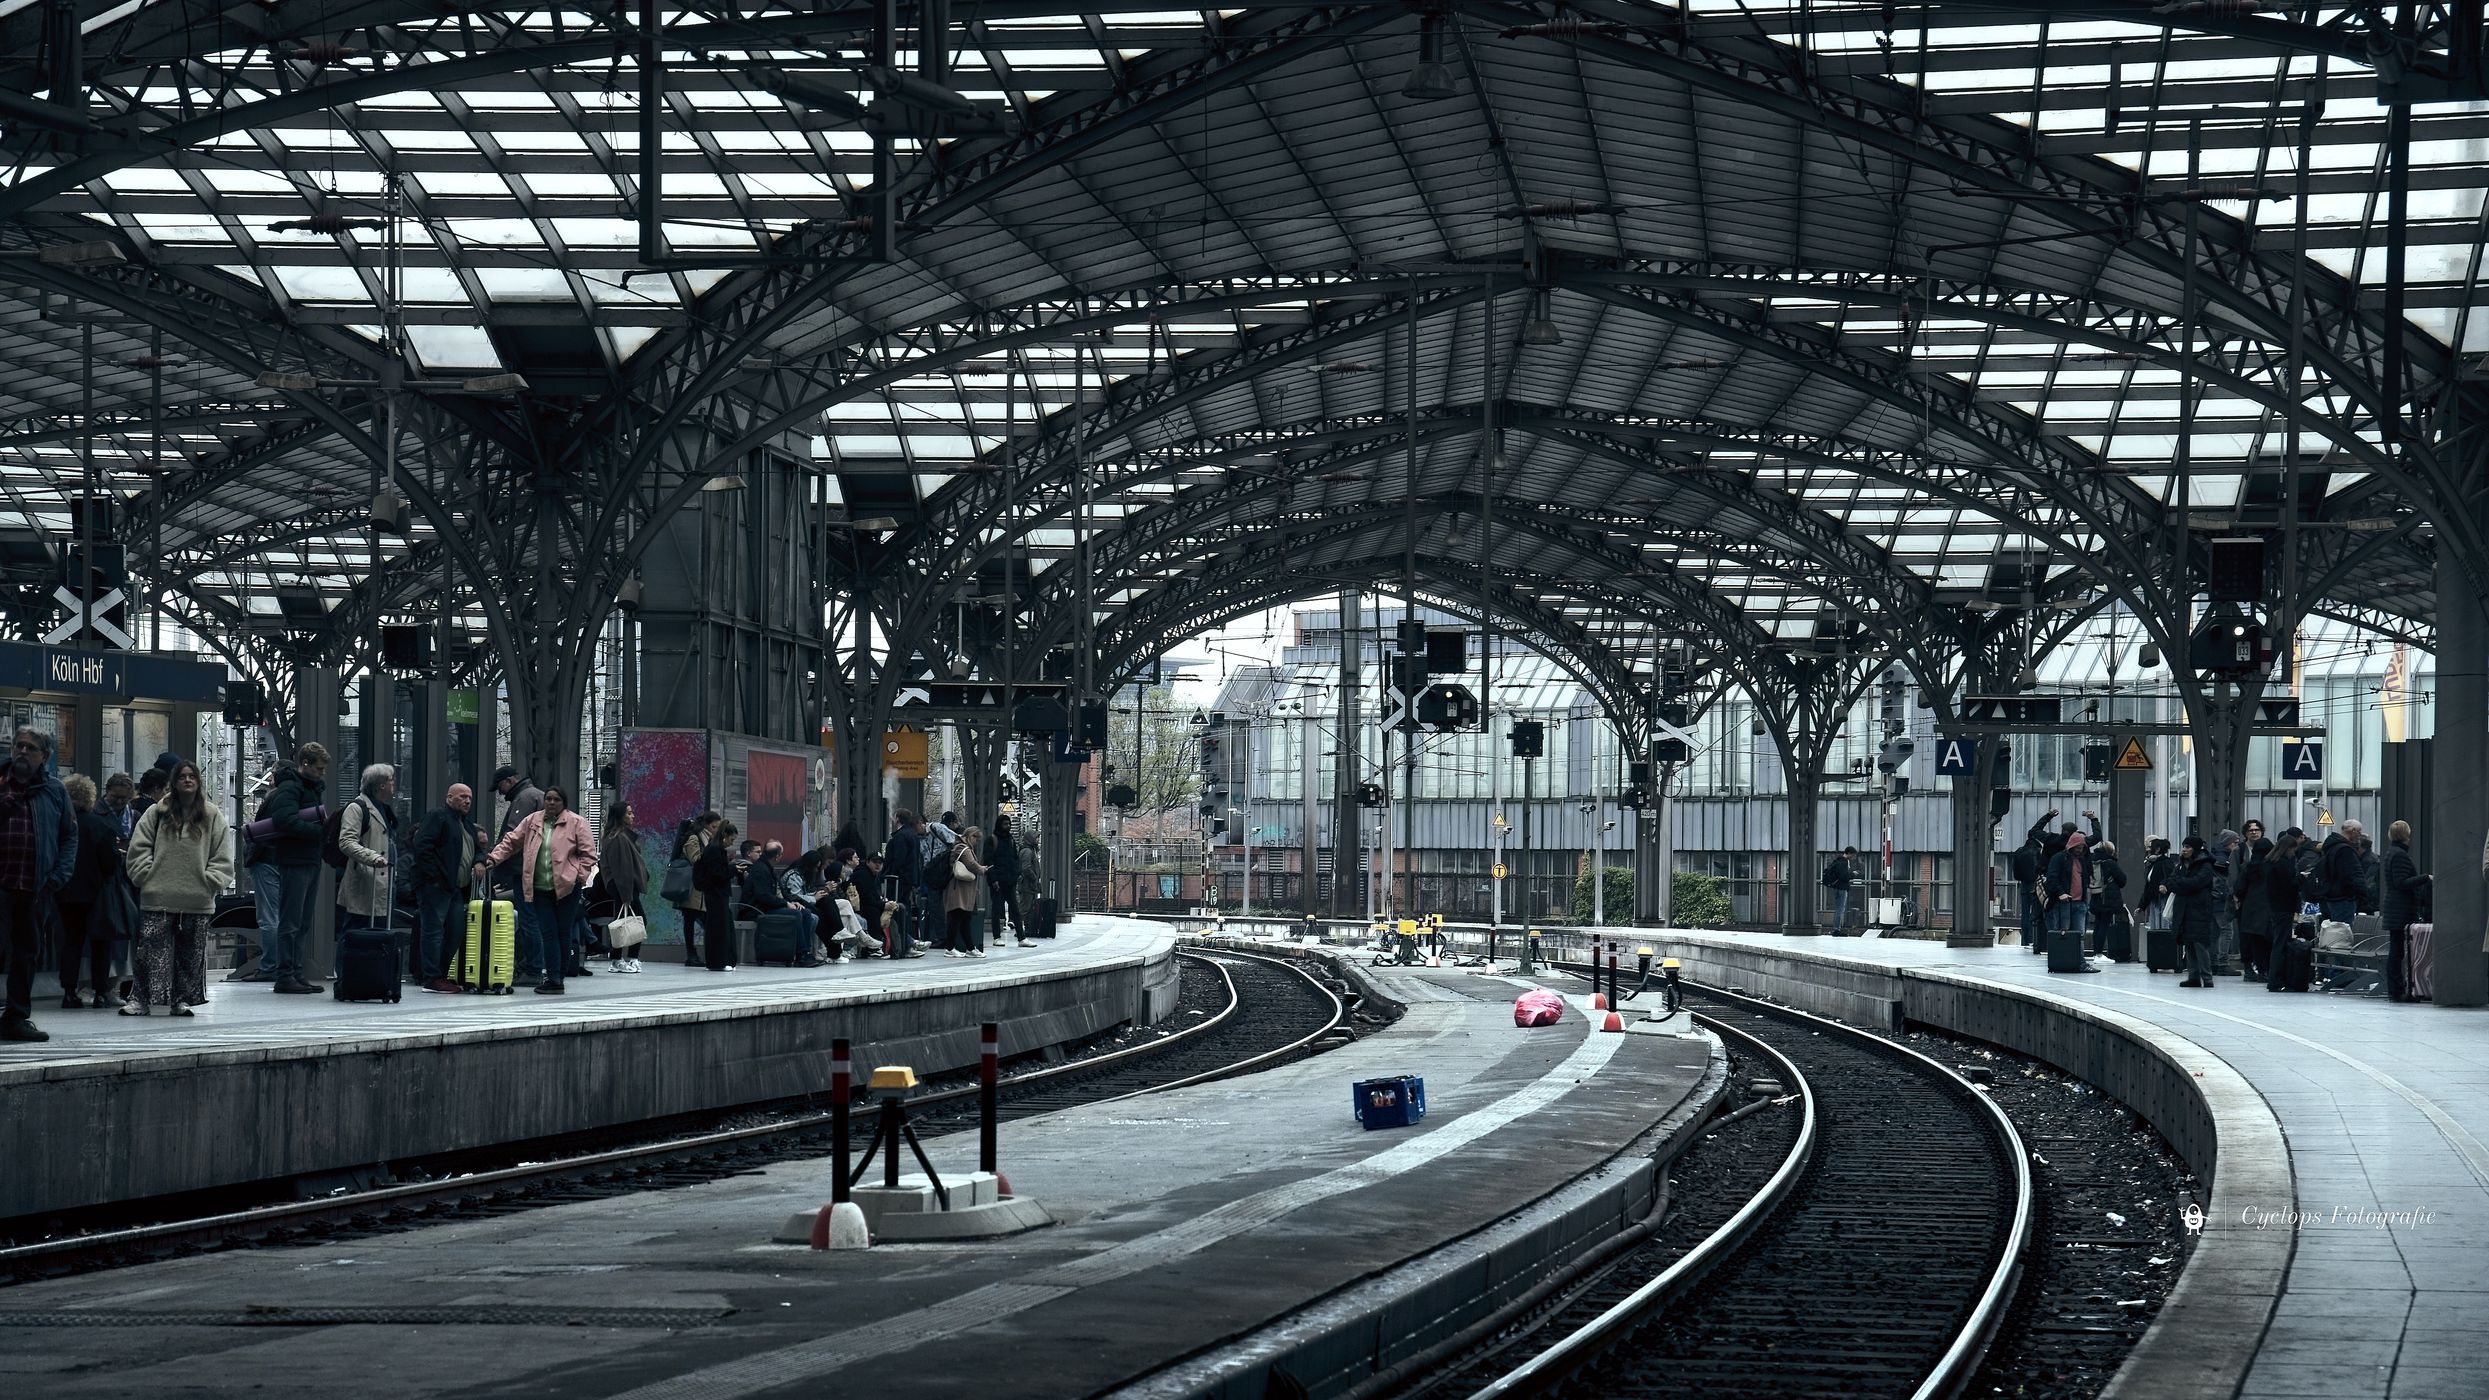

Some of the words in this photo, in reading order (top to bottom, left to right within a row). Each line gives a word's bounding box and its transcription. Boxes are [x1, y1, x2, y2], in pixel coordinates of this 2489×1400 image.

[52, 654, 79, 682] Köln
[82, 657, 104, 684] Hbf
[1942, 741, 1964, 767] A
[2294, 744, 2317, 771] A
